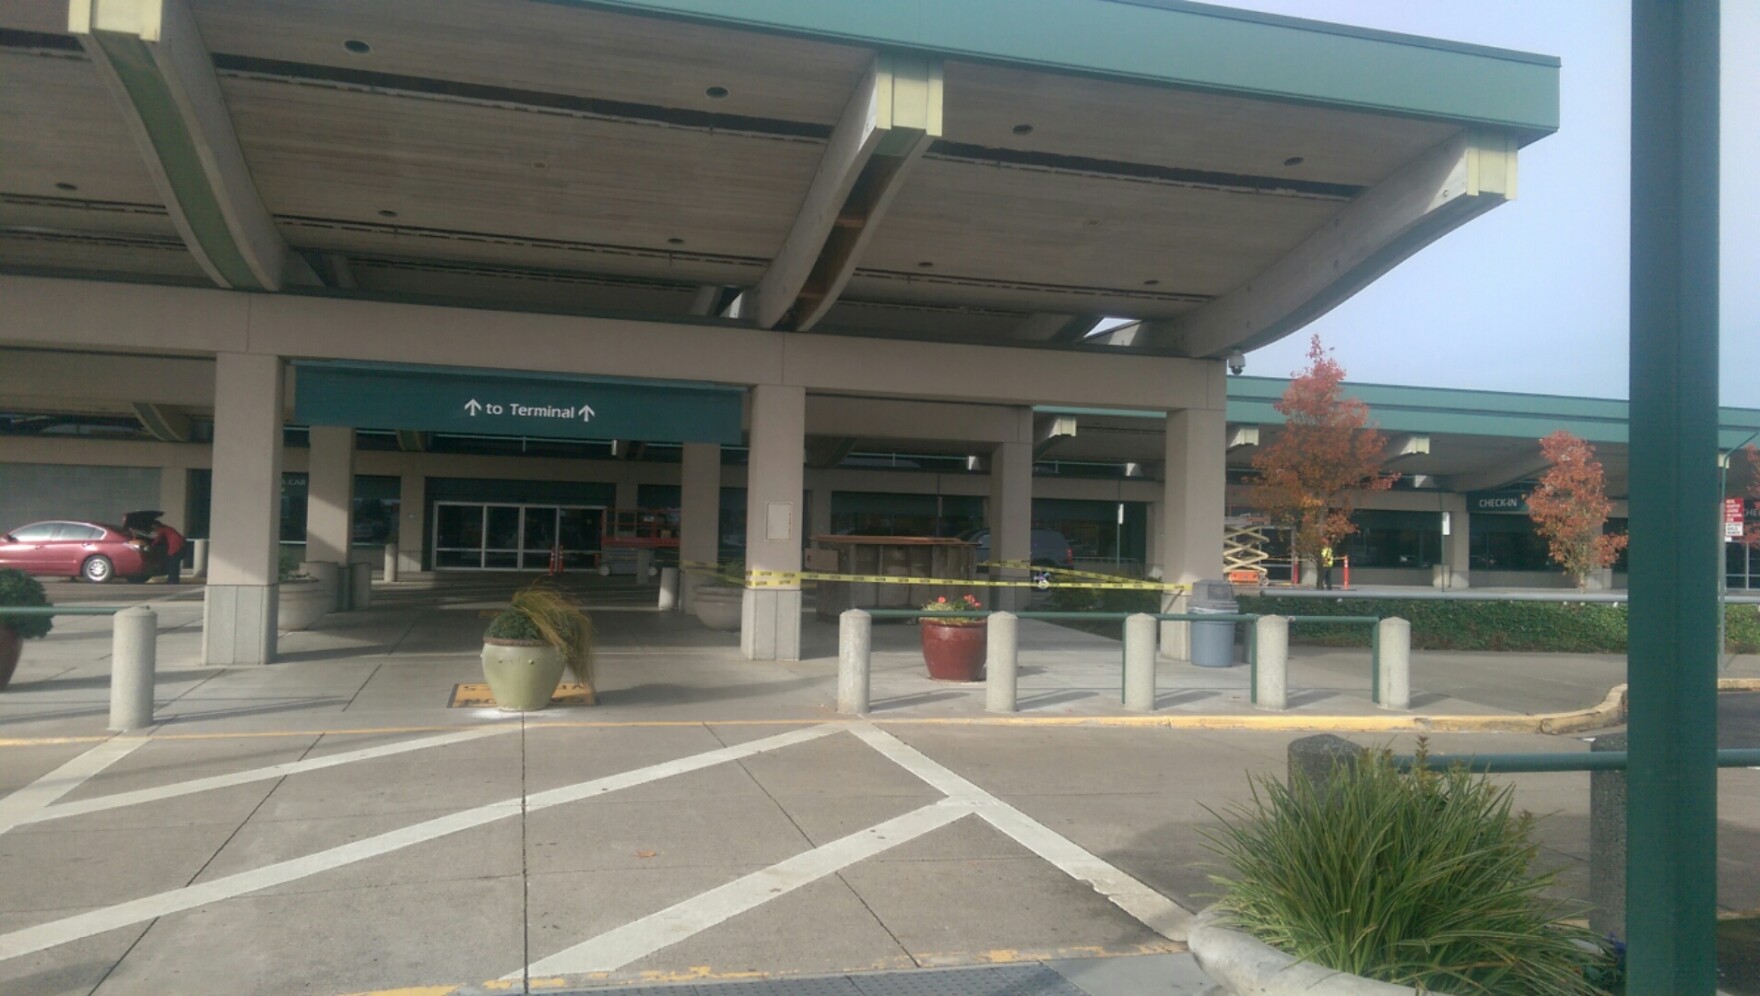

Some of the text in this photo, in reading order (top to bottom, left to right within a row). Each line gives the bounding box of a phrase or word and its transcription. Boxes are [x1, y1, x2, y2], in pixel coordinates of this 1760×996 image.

[486, 403, 575, 419] to Terminal
[1479, 498, 1518, 508] CHECK-IN
